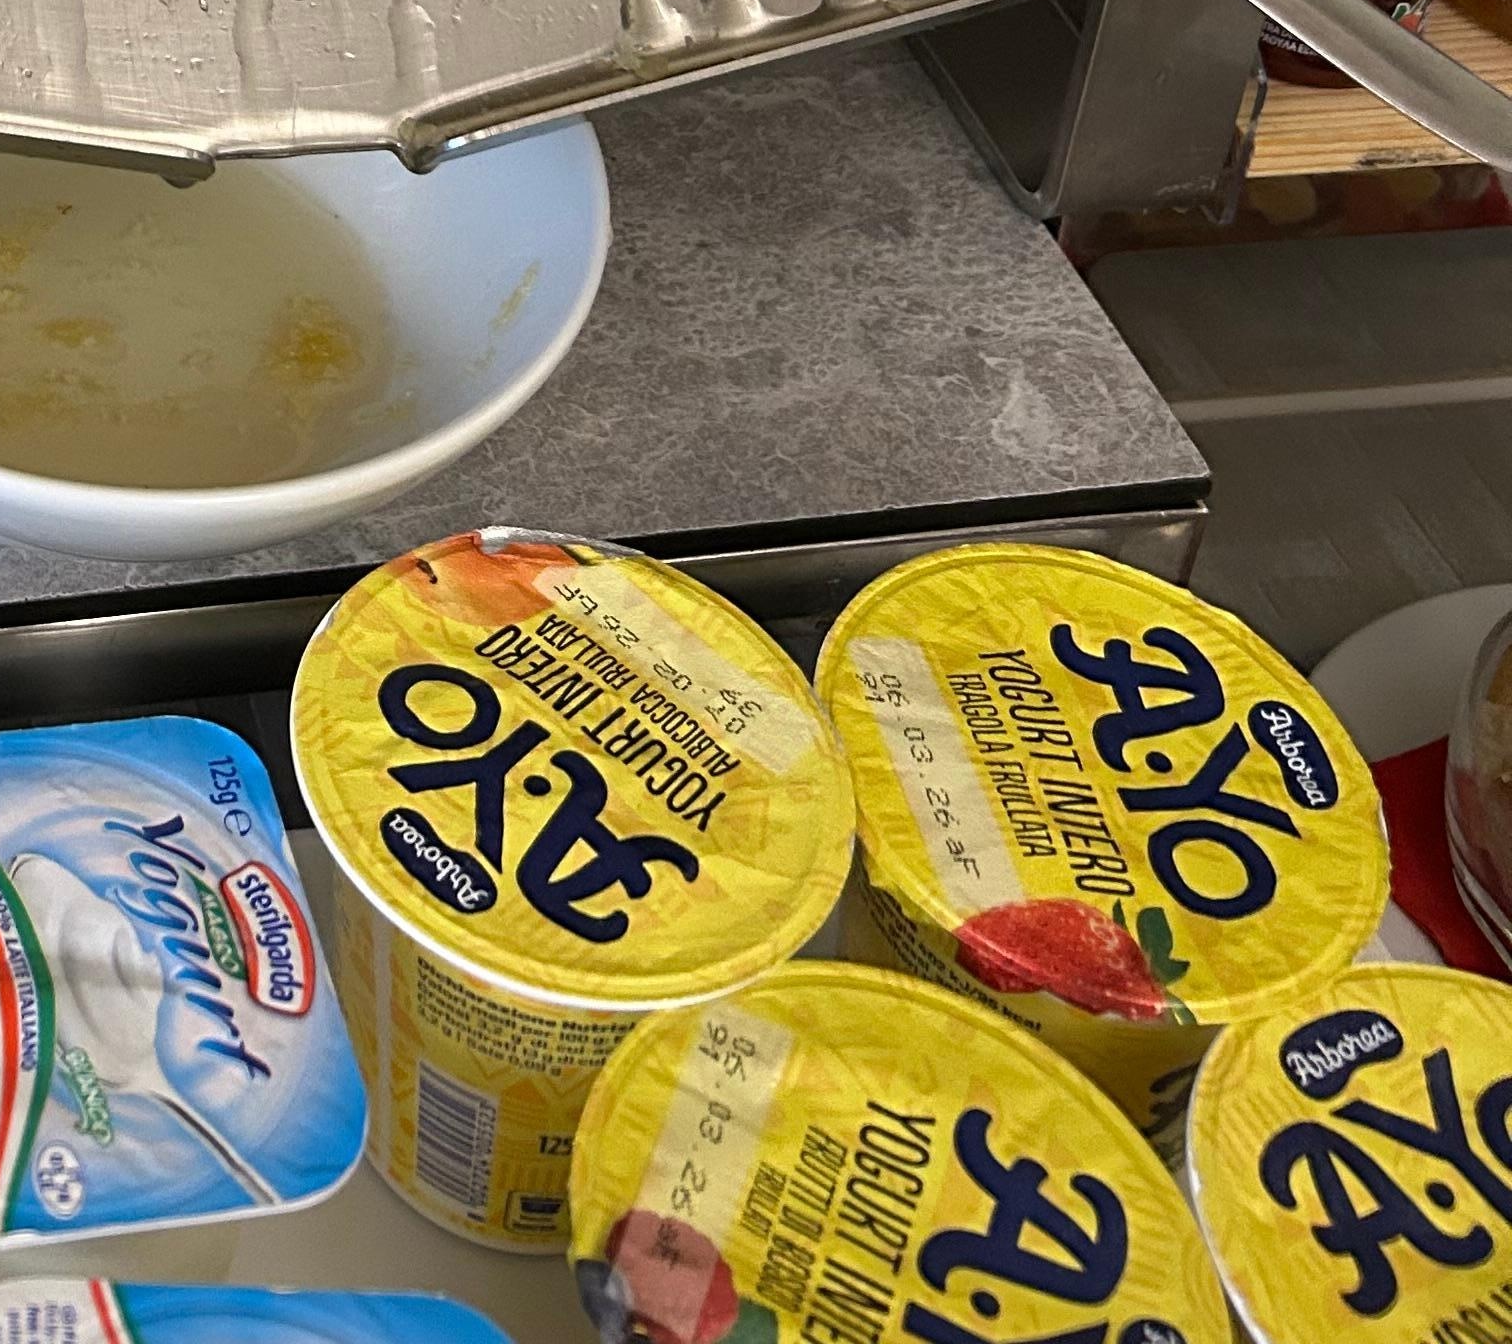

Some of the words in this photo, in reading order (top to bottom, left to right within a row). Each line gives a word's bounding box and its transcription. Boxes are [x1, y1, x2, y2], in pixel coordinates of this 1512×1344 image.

[474, 624, 604, 721] INTERO
[536, 614, 638, 692] FRULLATA
[581, 707, 727, 832] YOGURT
[630, 682, 740, 778] ALBICOCCA
[946, 673, 1015, 754] FRAGOLA
[984, 761, 1057, 857] FRULLATA
[978, 649, 1084, 772] YOGURT
[1038, 777, 1136, 897] INTERO
[1261, 707, 1328, 806] Arborea
[208, 755, 241, 805] 125g
[389, 814, 489, 910] Arborea
[104, 814, 272, 1079] Yogurt
[237, 872, 303, 1002] sterilgarda
[5, 939, 31, 978] LATTE
[18, 983, 37, 1071] ITALIANO
[1287, 1021, 1397, 1087] Arborea
[788, 1124, 849, 1216] FRUTTI
[835, 1100, 937, 1276] YOGURT
[779, 1205, 824, 1243] DI
[756, 1234, 816, 1313] BOSCO
[800, 1257, 895, 1344] INTE
